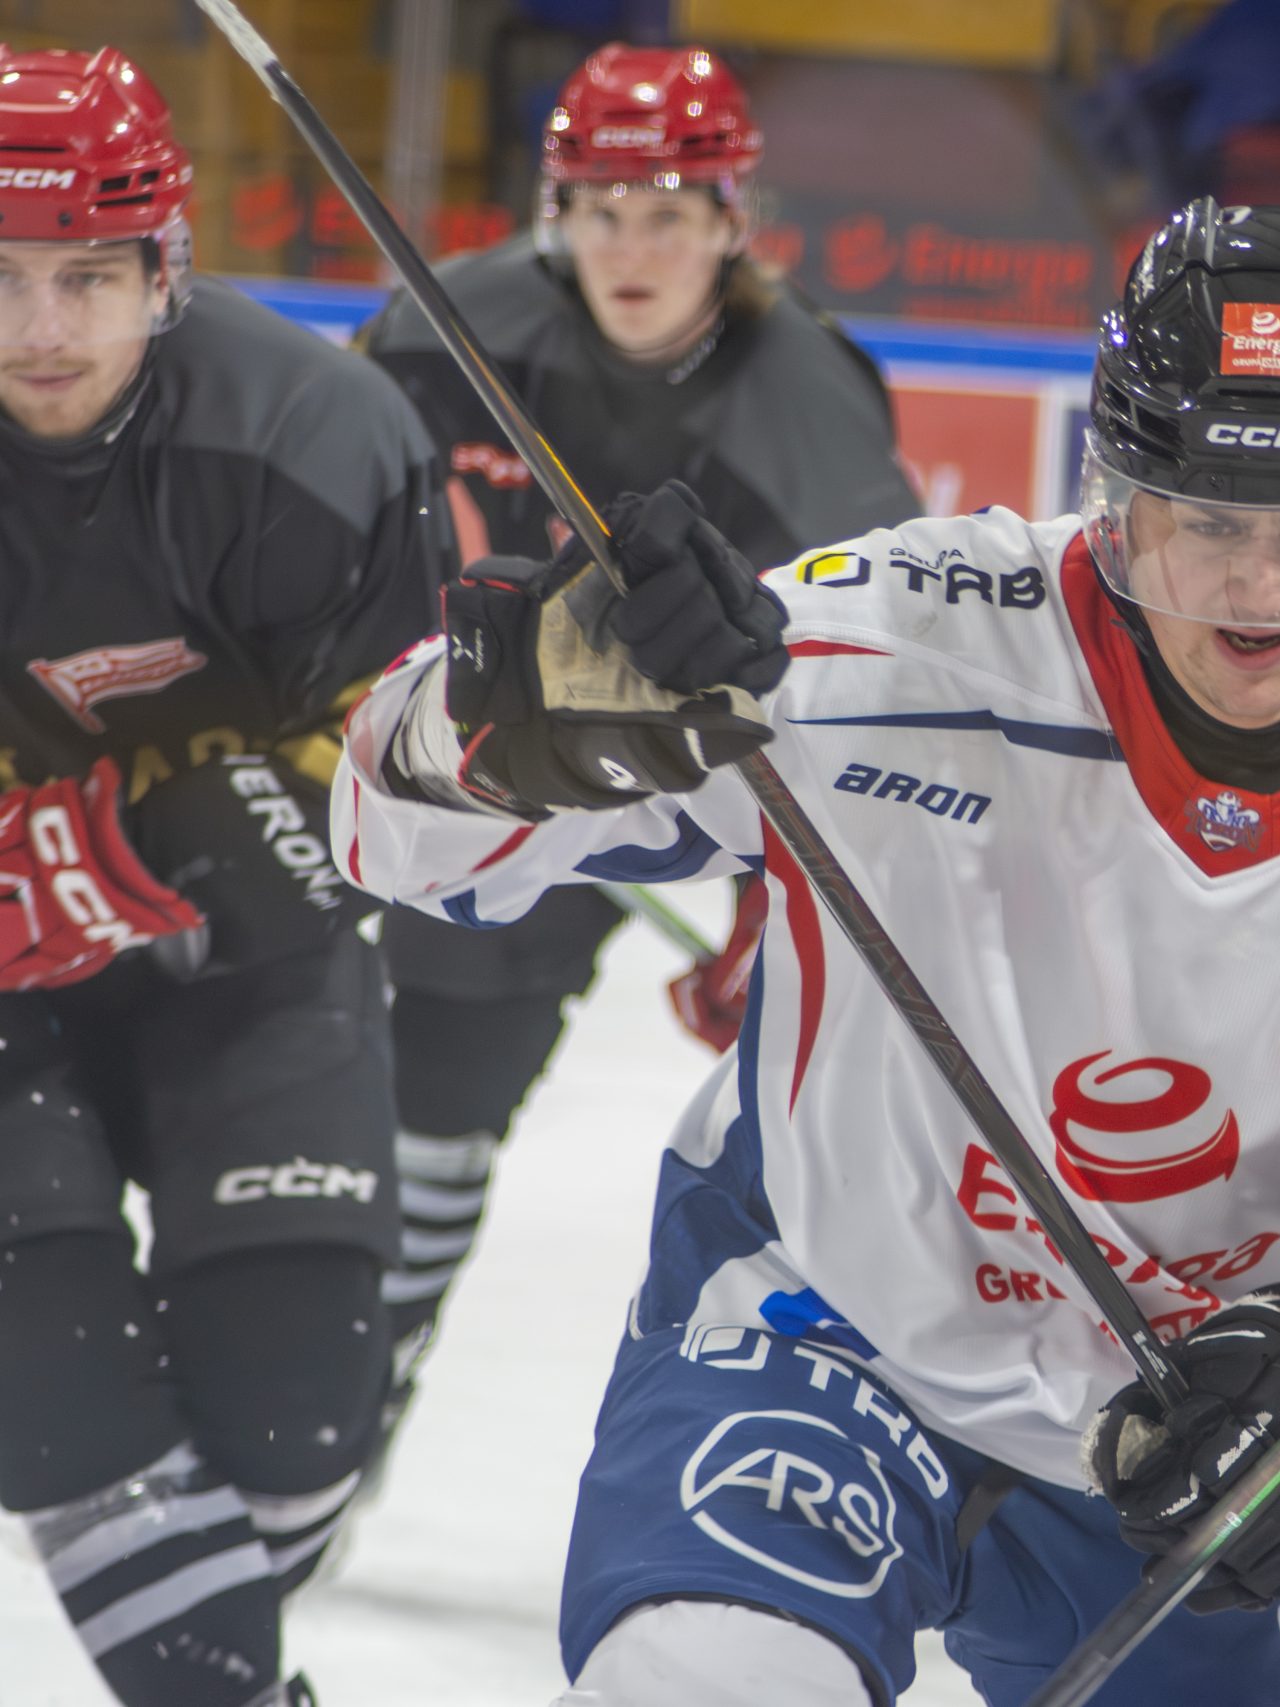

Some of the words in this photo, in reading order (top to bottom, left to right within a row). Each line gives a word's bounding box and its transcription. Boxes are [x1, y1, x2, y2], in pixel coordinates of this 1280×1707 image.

[889, 560, 1046, 610] TRB
[213, 1155, 379, 1205] CCM
[690, 1447, 885, 1558] ARS
